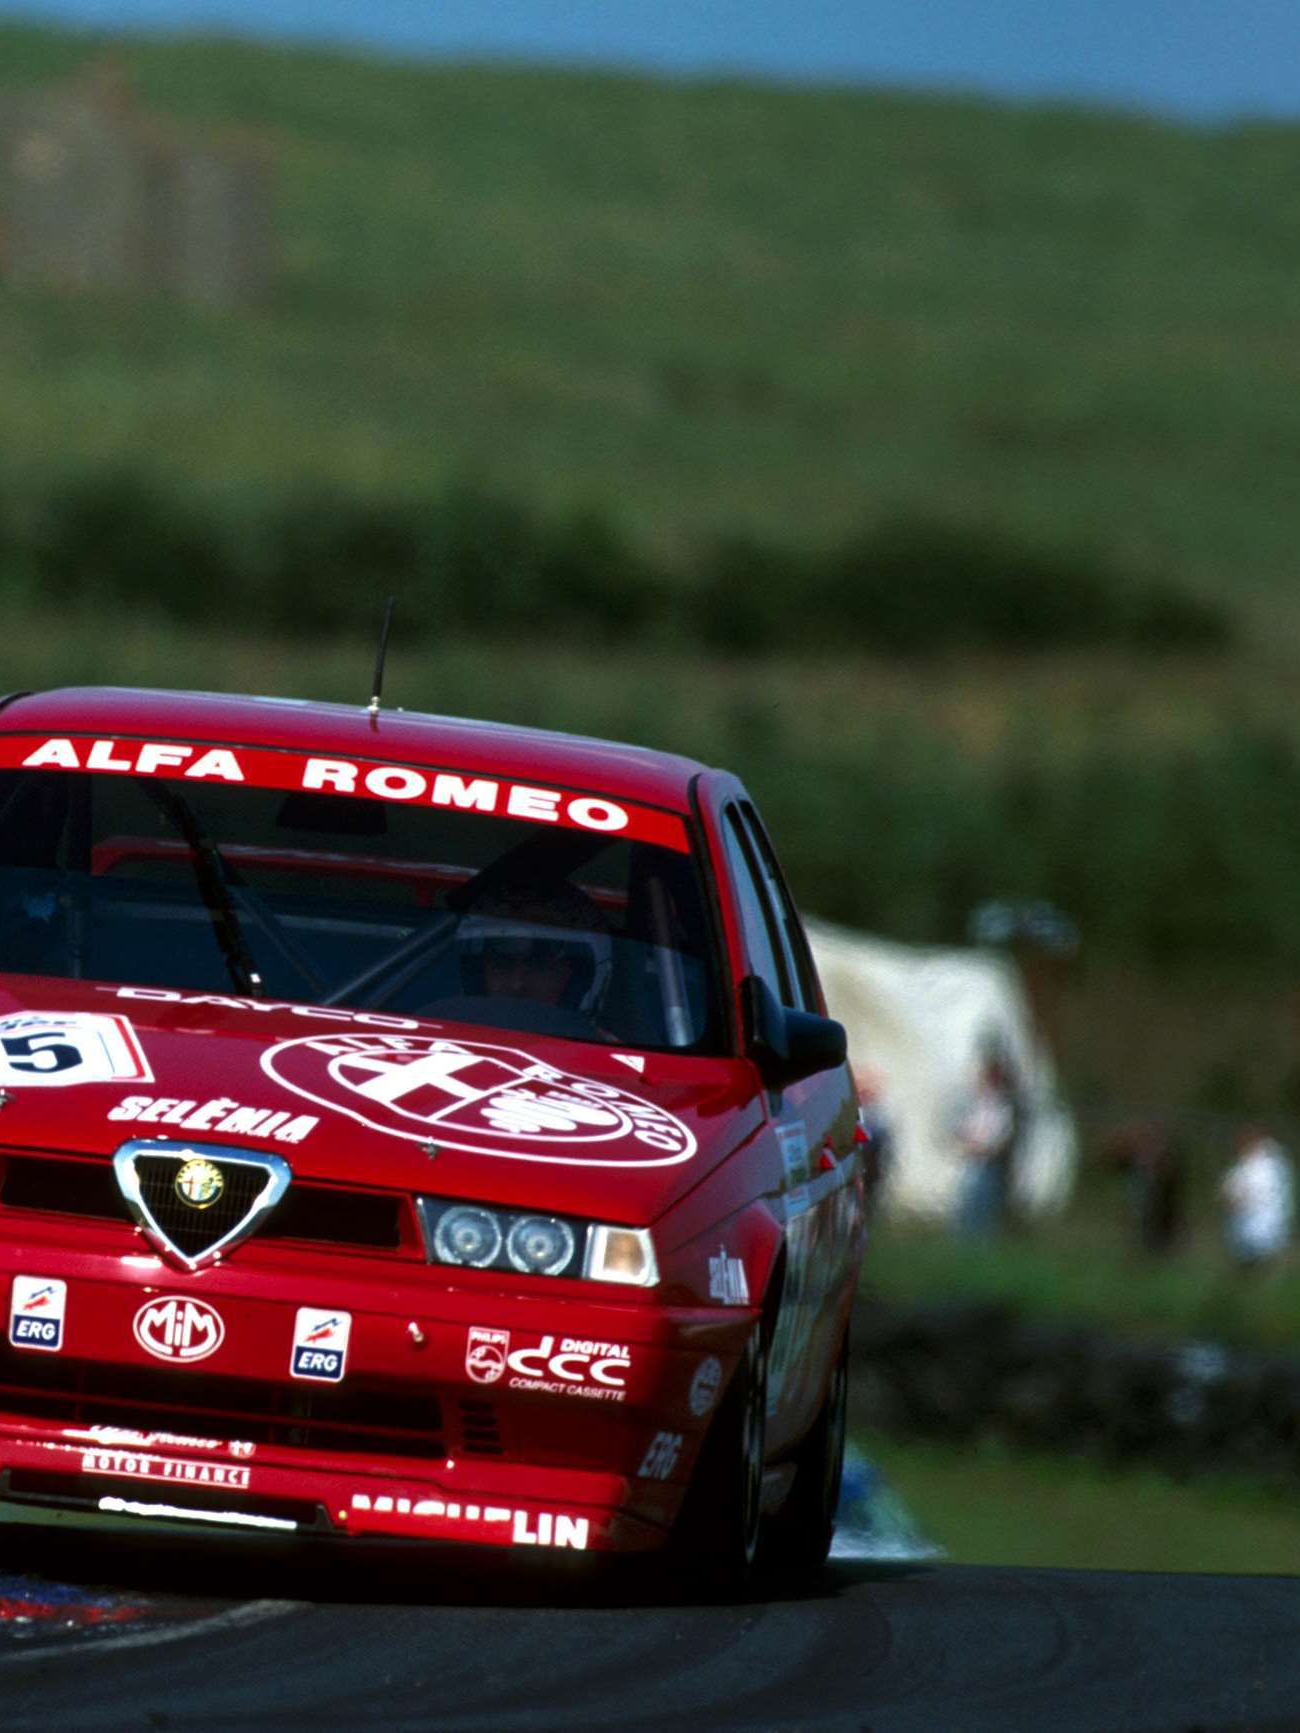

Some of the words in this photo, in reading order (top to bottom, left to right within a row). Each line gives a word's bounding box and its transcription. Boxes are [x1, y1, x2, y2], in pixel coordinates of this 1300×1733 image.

[22, 738, 245, 782] ALFA
[302, 757, 629, 832] ROMEO
[116, 986, 419, 1030] DAYCO
[304, 1035, 474, 1056] ALFA
[523, 1063, 684, 1151] ROMEO
[15, 1319, 56, 1340] ERG
[298, 1351, 338, 1373] ERG
[507, 1335, 631, 1386] dcc
[560, 1338, 631, 1360] DIGITAL
[509, 1377, 564, 1395] COMPACT
[566, 1384, 626, 1401] CASSETTE
[82, 1453, 151, 1474] MOTOR
[163, 1464, 249, 1486] FINANCE
